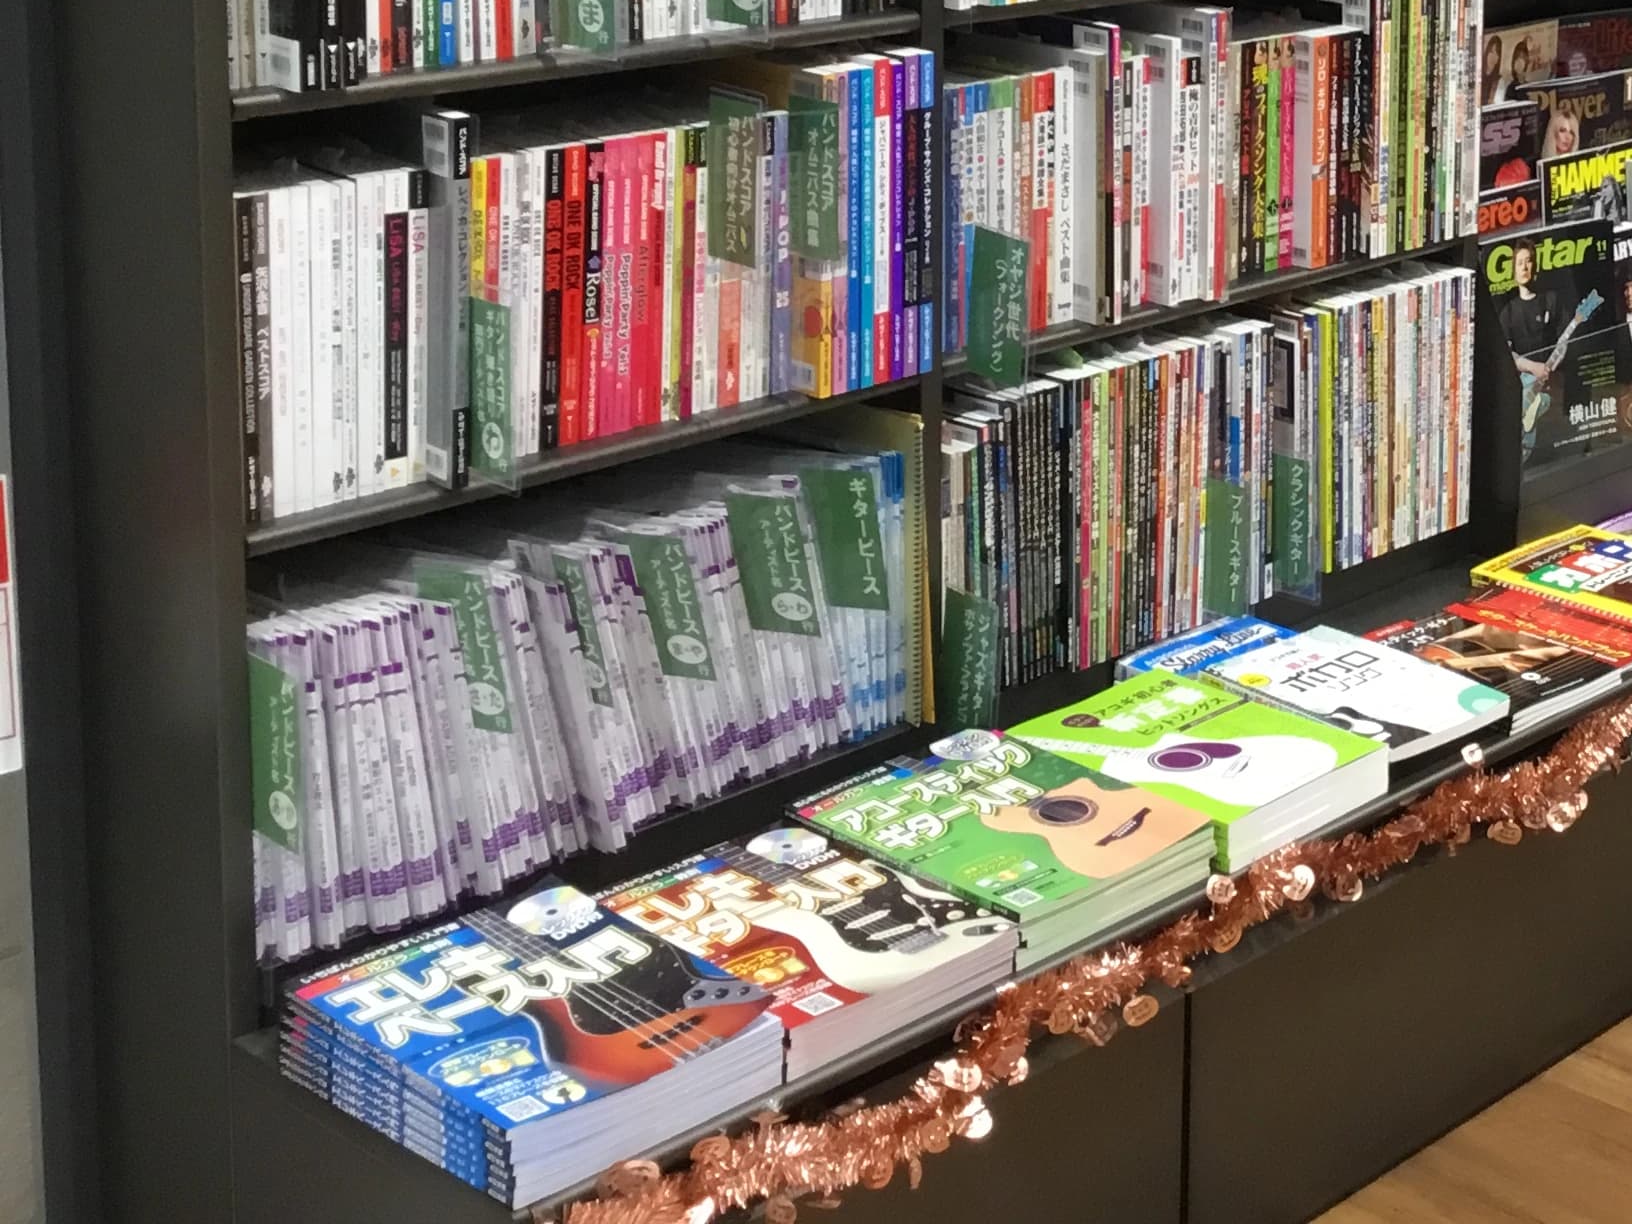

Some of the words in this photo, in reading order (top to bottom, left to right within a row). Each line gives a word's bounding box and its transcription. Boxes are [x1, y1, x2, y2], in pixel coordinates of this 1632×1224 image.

[741, 115, 755, 217] バンドスコア
[806, 130, 820, 247] オムニバス曲集
[822, 112, 835, 211] バンドスコア
[546, 200, 559, 228] ONE
[546, 231, 560, 251] OK
[566, 200, 579, 228] ONE
[567, 231, 580, 251] OK
[1596, 240, 1607, 254] 11
[547, 253, 561, 292] ROCK
[568, 254, 581, 291] ROCK
[1569, 397, 1617, 425] 横山健
[774, 504, 807, 593] バンドピース
[848, 477, 881, 595] ギターピース
[1229, 495, 1243, 603] ブルースギター
[1290, 464, 1304, 576] クラシックギター
[664, 543, 699, 635] バンドピース
[462, 579, 498, 682] バンドピース
[1094, 679, 1178, 719] アコギ初心者
[1280, 650, 1380, 692] ボカロ
[1137, 696, 1227, 737] ヒットソングス
[828, 744, 1033, 835] アコースティック
[871, 778, 1046, 852] ギター入門
[614, 867, 763, 937] エレキ
[324, 939, 519, 1022] エレキ
[371, 923, 653, 1051] ベース入門
